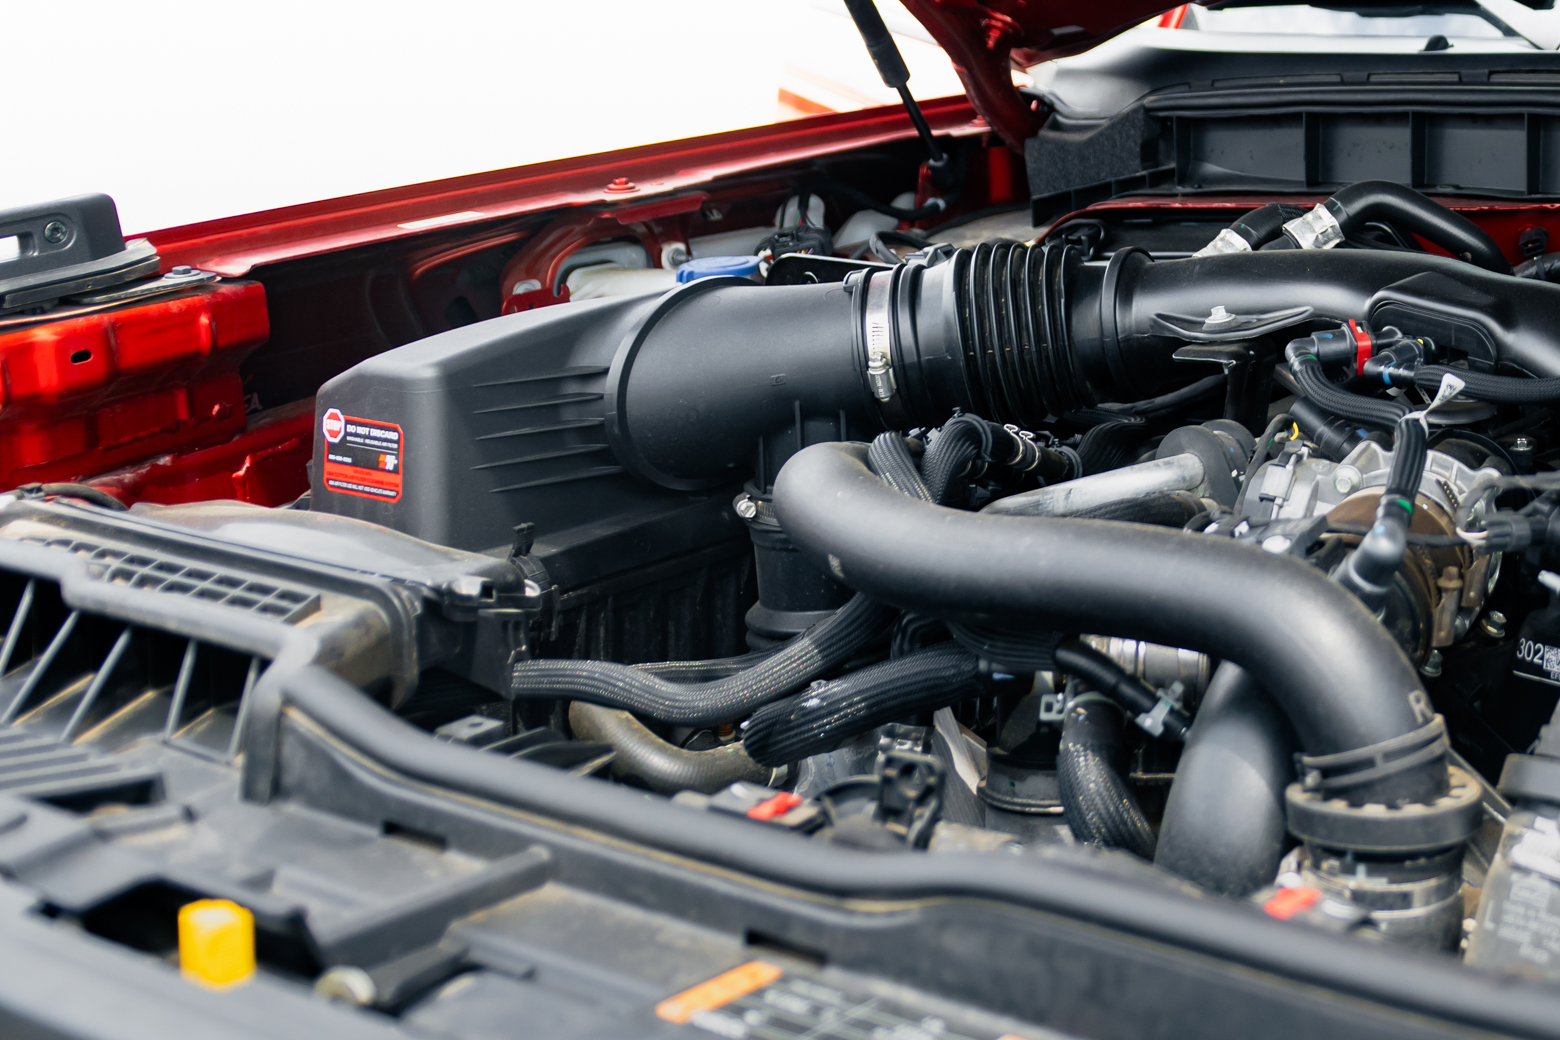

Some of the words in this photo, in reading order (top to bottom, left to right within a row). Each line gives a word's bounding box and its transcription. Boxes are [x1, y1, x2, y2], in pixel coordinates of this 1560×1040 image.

[326, 418, 342, 431] STOP
[346, 424, 356, 433] DO
[356, 426, 370, 435] NOT
[370, 428, 399, 440] DISCARD
[1516, 638, 1544, 664] 302
[1408, 690, 1434, 723] R
